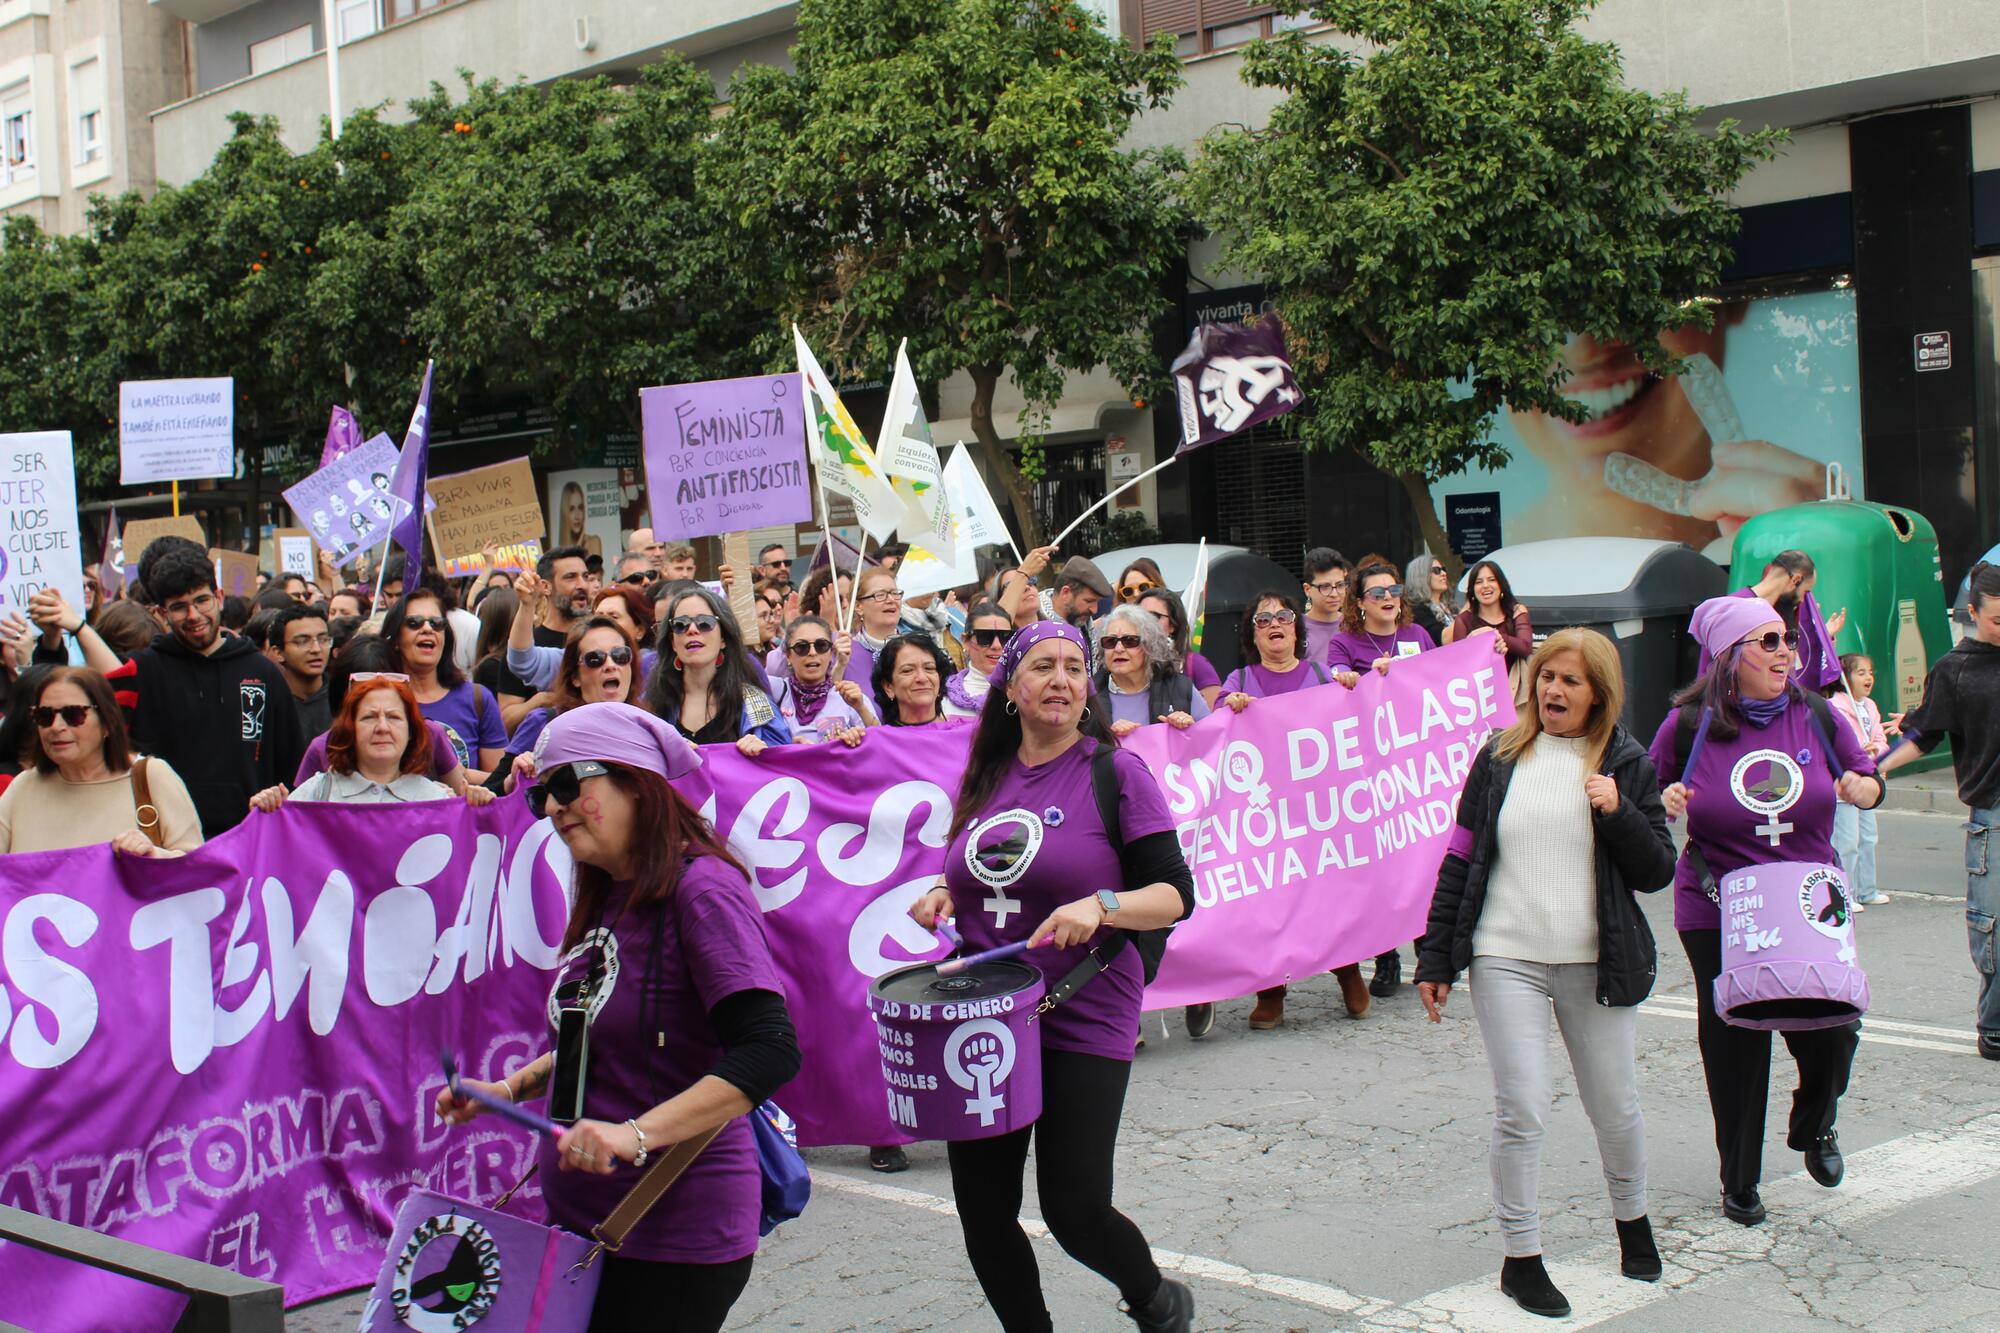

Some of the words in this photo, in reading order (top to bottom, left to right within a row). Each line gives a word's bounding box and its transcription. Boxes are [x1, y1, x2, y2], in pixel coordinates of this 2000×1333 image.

[1196, 301, 1253, 321] vivanta
[675, 400, 784, 449] FEMINISTA
[12, 452, 47, 473] SER
[669, 452, 695, 473] POR
[435, 487, 472, 505] PARA
[476, 476, 512, 494] VIVIR
[676, 460, 802, 505] ANTIFASCISTA
[11, 509, 49, 532] NOS
[440, 510, 456, 523] EL
[679, 507, 704, 528] POR
[9, 531, 71, 554] CUESTE
[442, 526, 468, 541] HAY
[289, 552, 305, 562] NO
[455, 543, 470, 555] EL
[19, 556, 43, 577] LA
[1287, 716, 1364, 782] DE
[1373, 667, 1498, 757] CLASE
[1316, 833, 1370, 876] AL
[978, 871, 994, 883] para
[994, 875, 1011, 883] tanta
[1727, 875, 1757, 896] RED
[1801, 868, 1829, 901] HABRÁ
[1728, 894, 1764, 915] FEMI
[1803, 904, 1817, 921] NO
[1731, 911, 1755, 931] NIS
[909, 1004, 932, 1021] DE
[942, 996, 1015, 1021] GENERO
[886, 1087, 918, 1129] 8M
